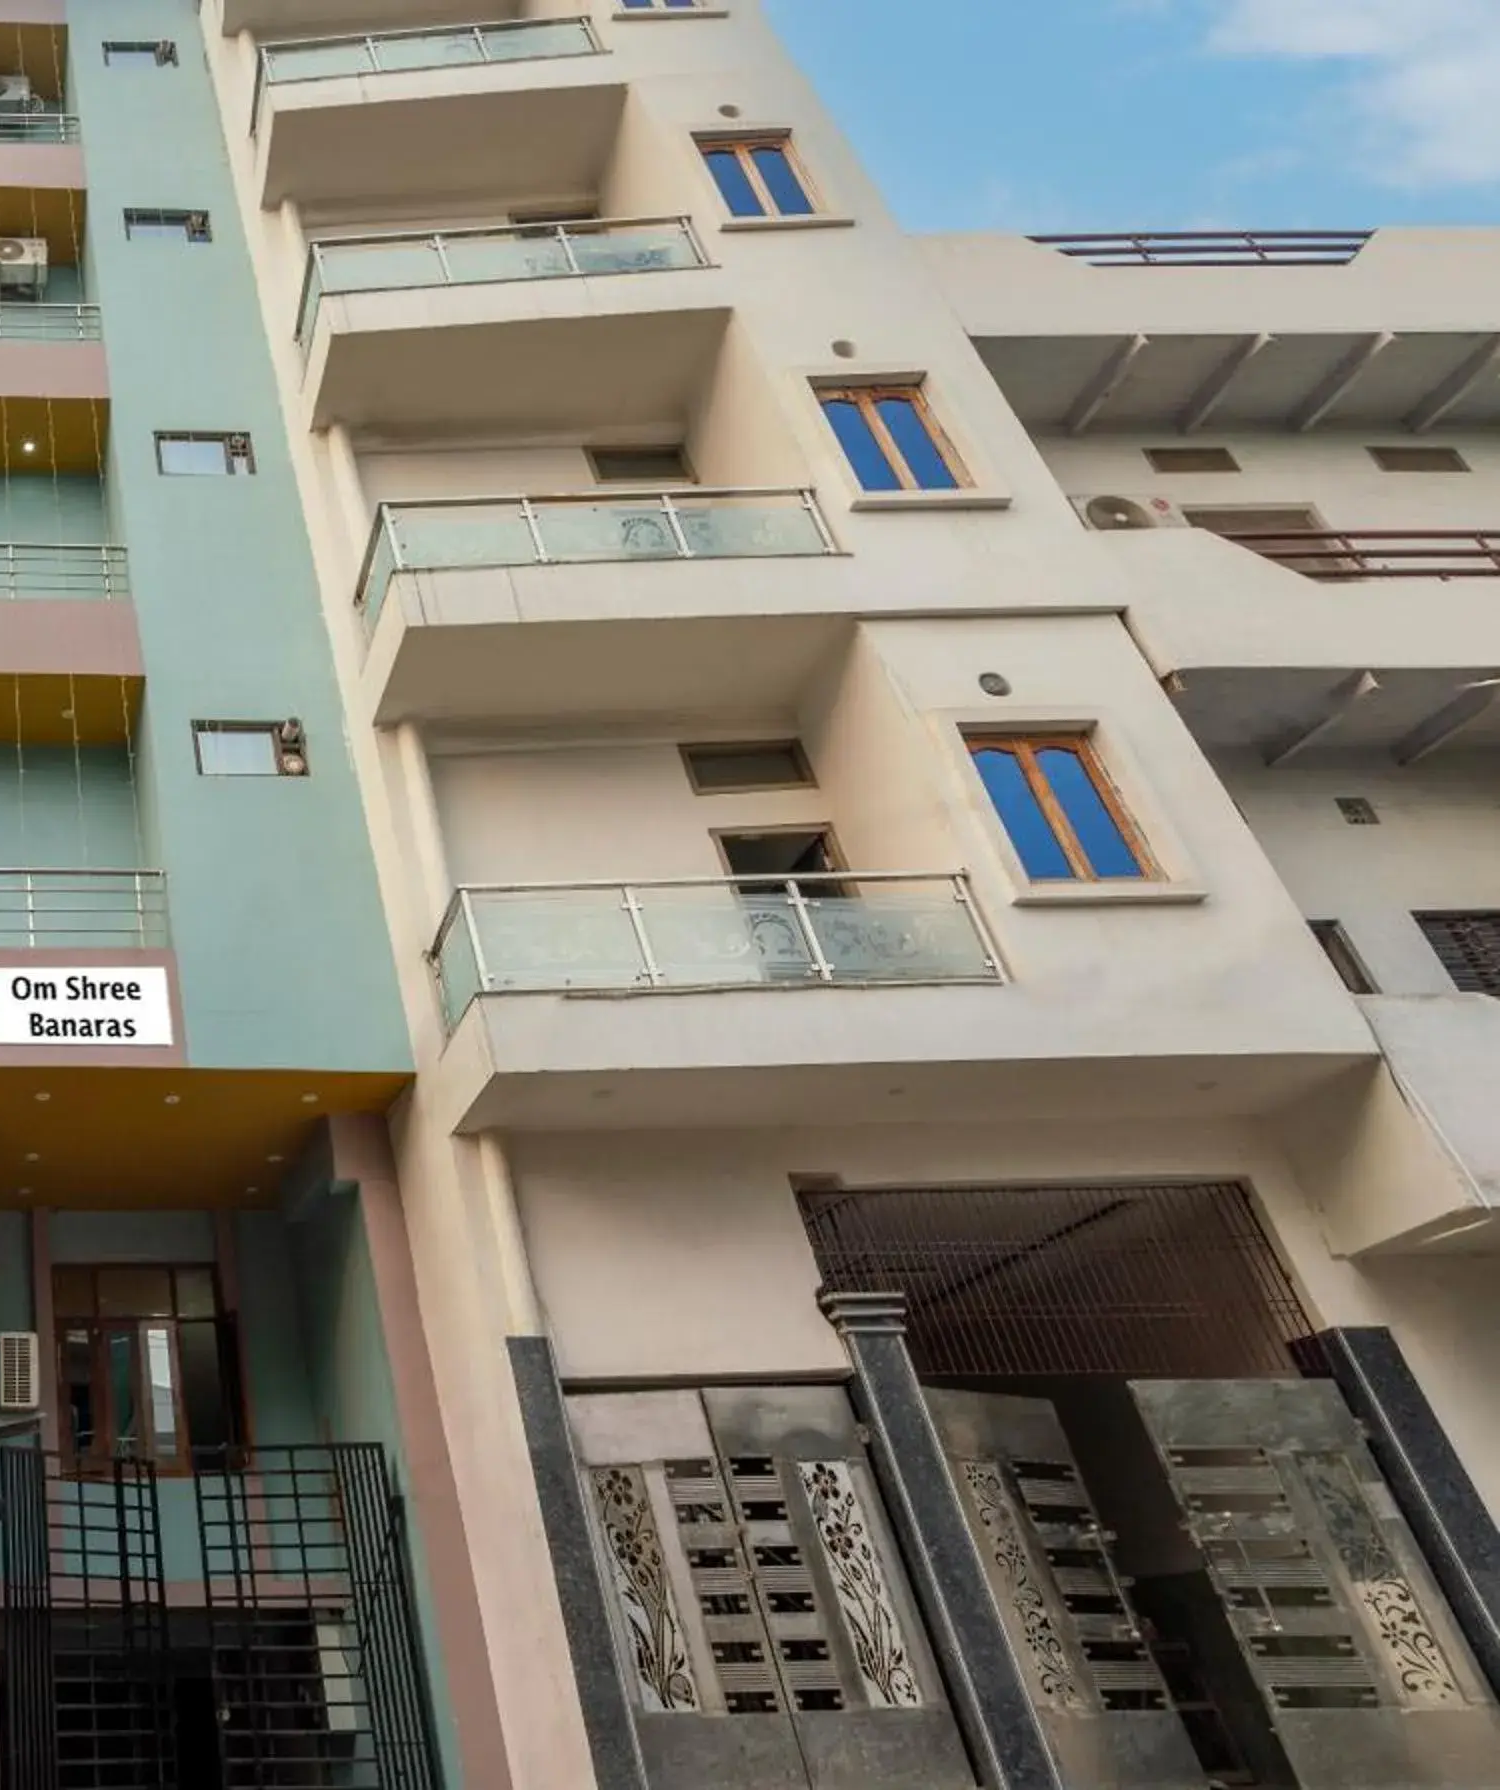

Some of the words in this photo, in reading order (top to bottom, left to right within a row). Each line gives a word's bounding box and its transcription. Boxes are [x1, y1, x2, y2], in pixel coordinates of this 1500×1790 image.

[11, 976, 57, 1001] Om
[65, 975, 142, 1001] Shree
[29, 1013, 137, 1038] Banaras
